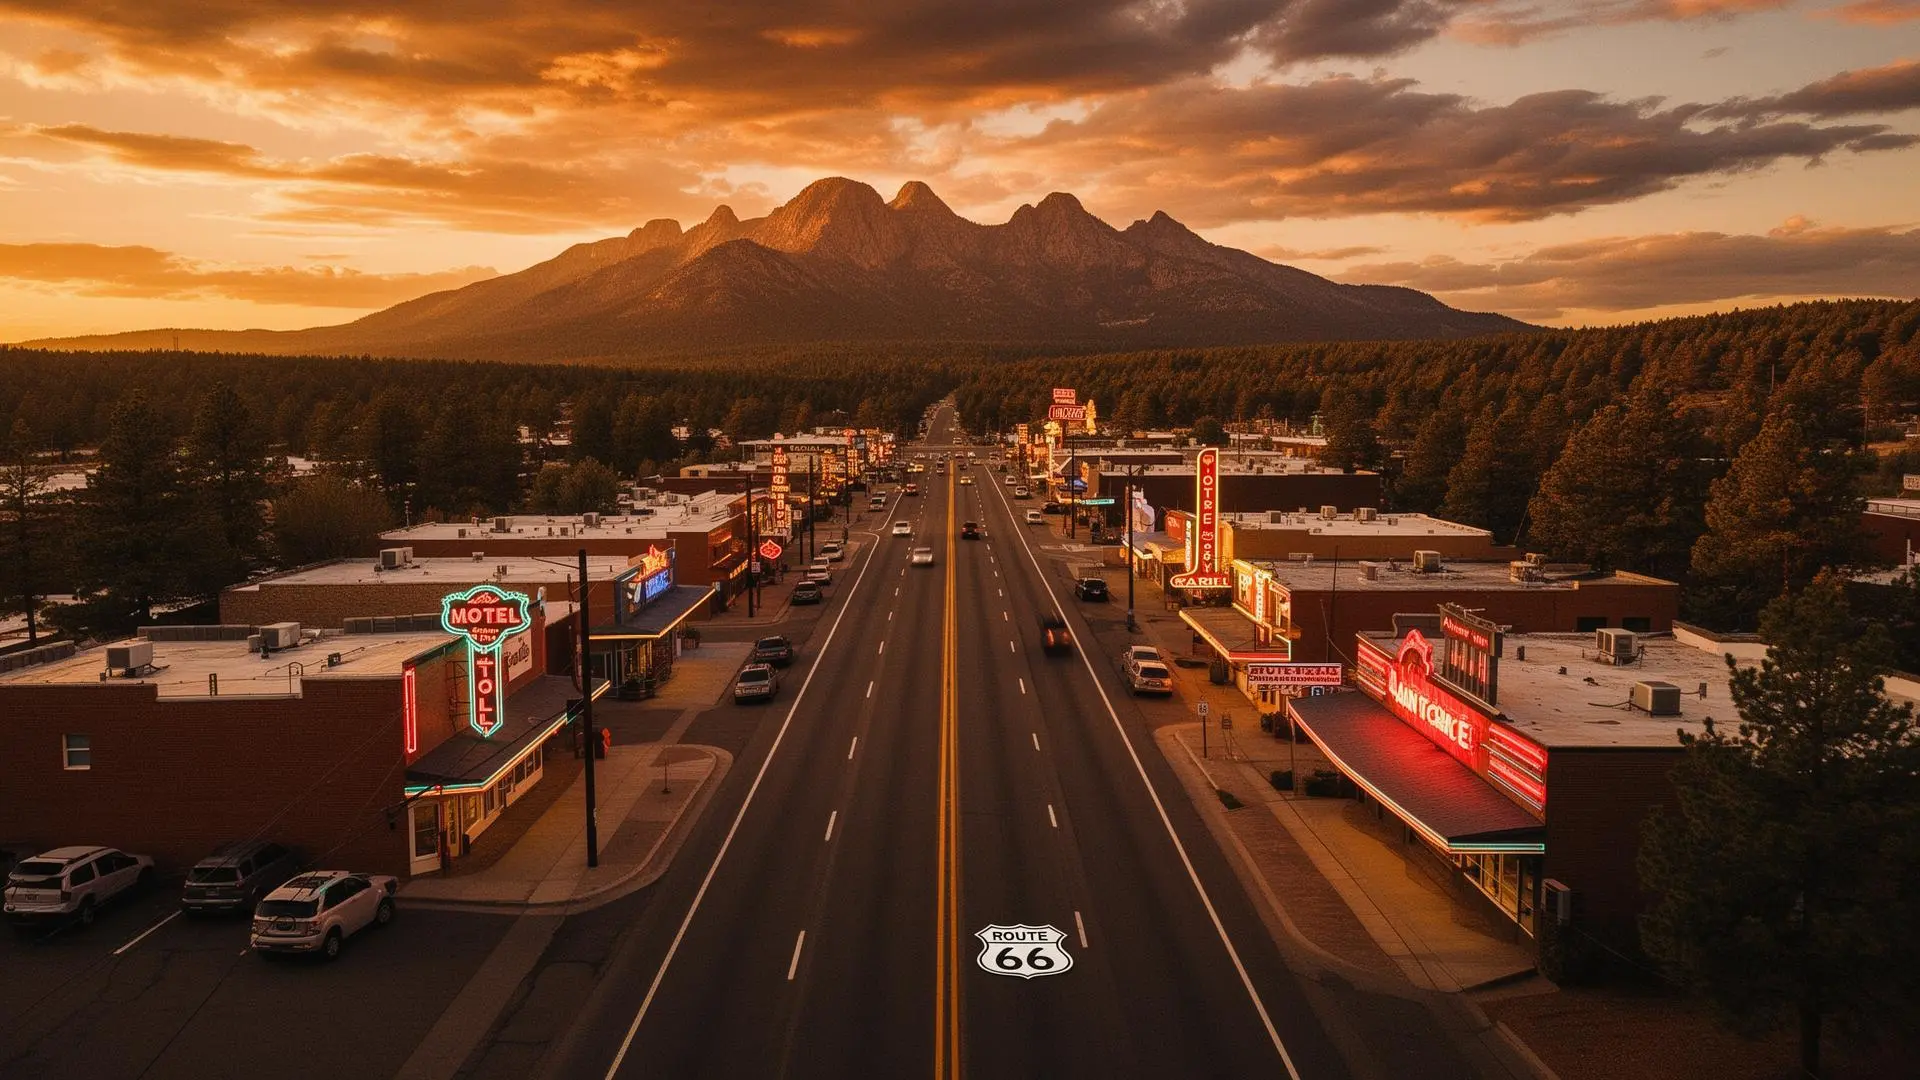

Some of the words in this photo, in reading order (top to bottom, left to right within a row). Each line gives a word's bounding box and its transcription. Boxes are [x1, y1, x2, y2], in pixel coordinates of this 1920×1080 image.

[451, 607, 520, 624] MOTEL
[993, 931, 1048, 941] ROUTE
[995, 947, 1054, 970] 66
